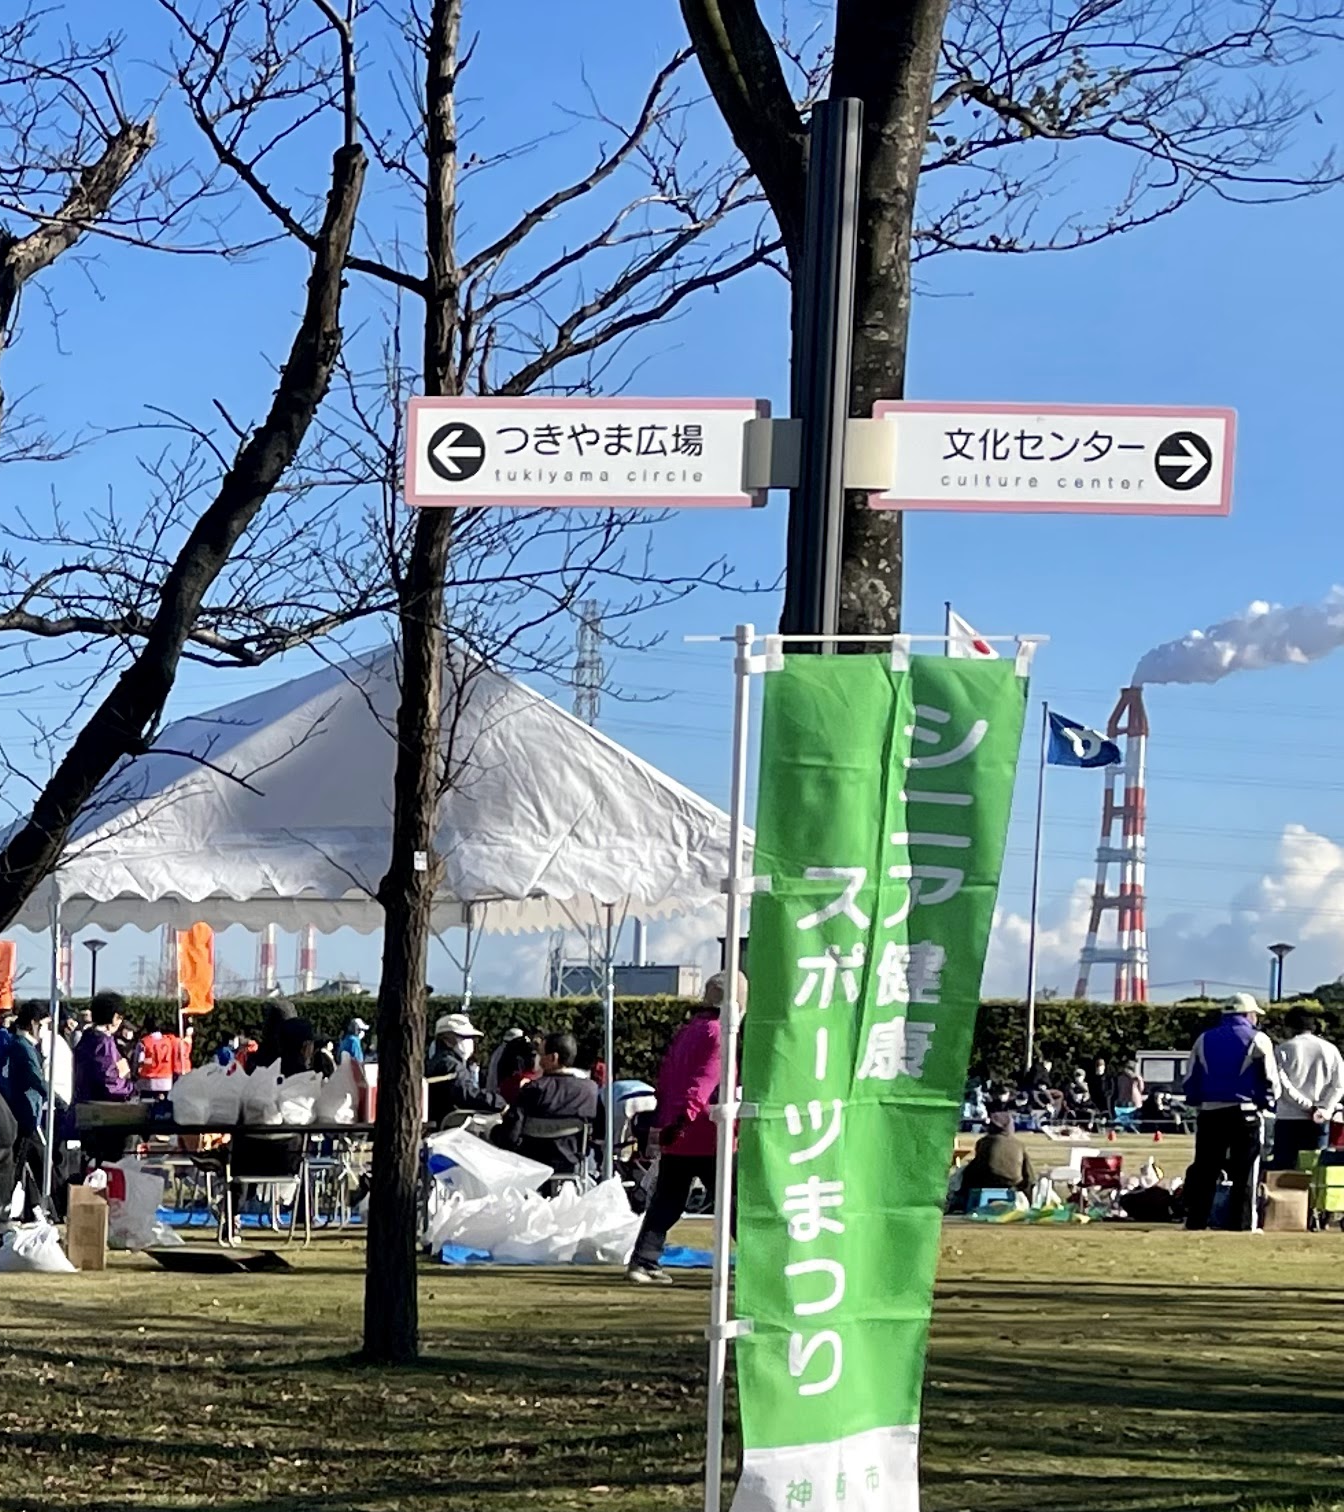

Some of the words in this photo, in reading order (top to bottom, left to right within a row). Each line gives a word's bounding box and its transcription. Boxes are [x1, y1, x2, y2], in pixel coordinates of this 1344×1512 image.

[496, 423, 704, 457] つきやま広場
[943, 428, 1146, 463] 文化センター
[494, 468, 609, 485] tukiyama
[626, 469, 703, 483] circle
[940, 473, 1040, 489] culture
[1057, 476, 1146, 490] center
[857, 703, 988, 1081] シニア健康
[783, 865, 871, 1397] スポーツまつり
